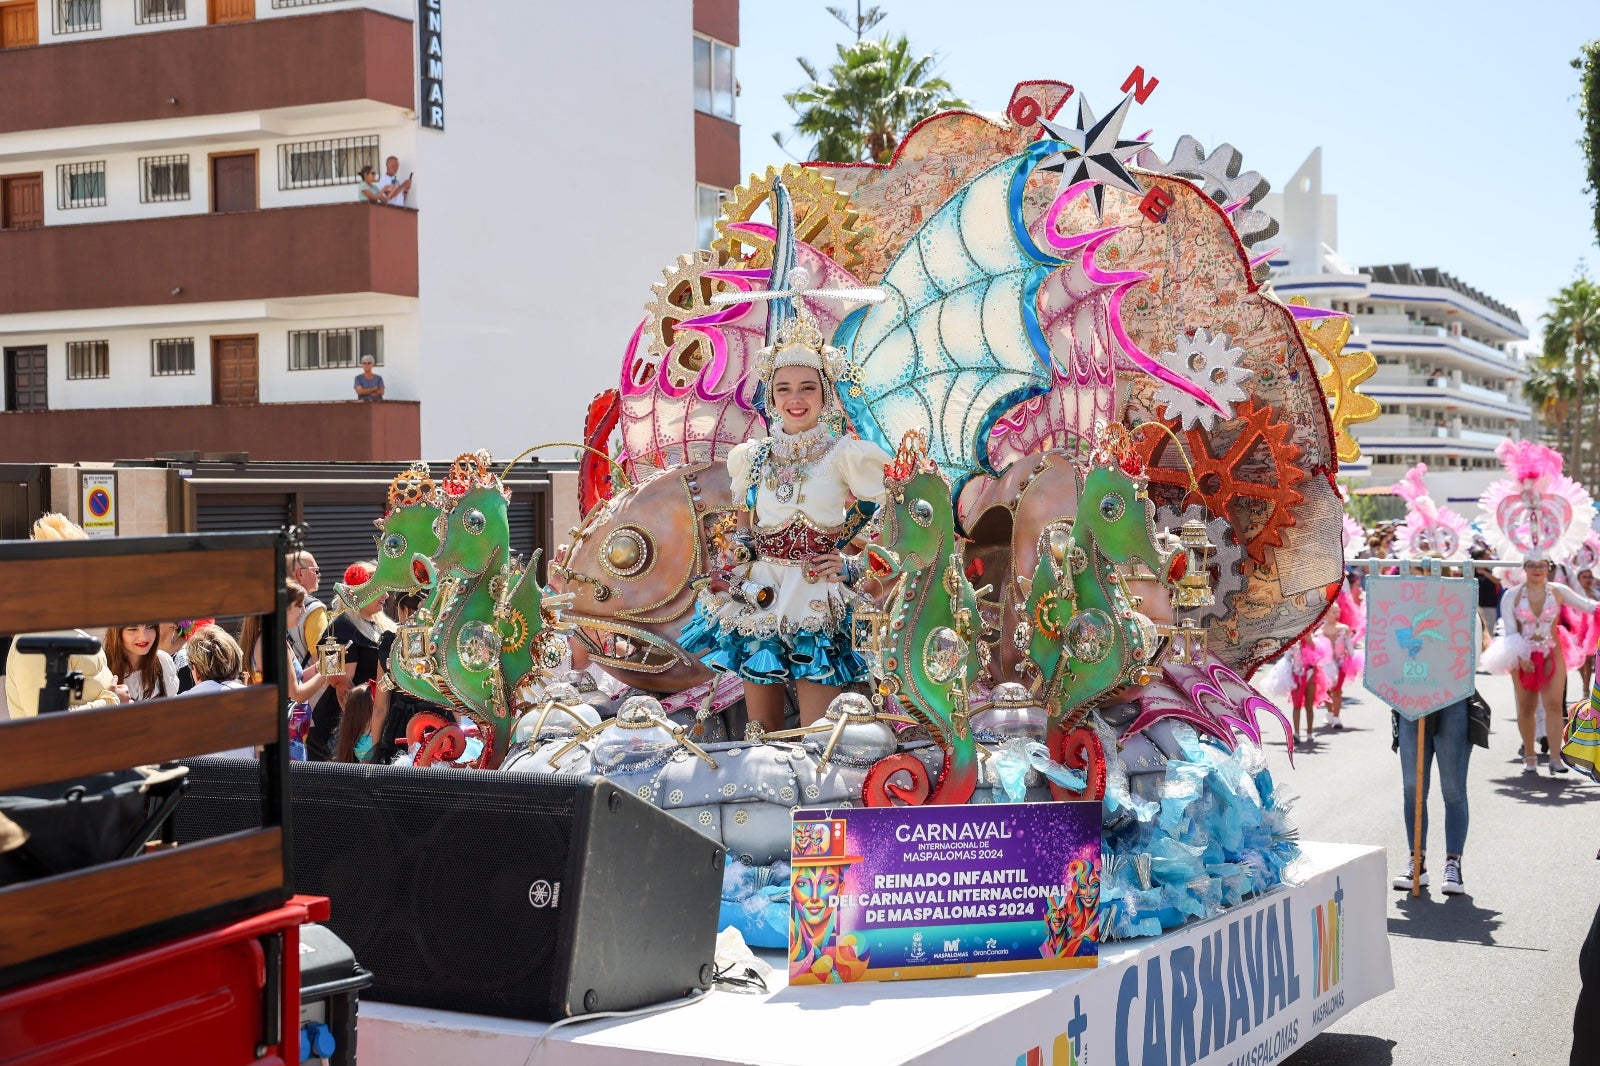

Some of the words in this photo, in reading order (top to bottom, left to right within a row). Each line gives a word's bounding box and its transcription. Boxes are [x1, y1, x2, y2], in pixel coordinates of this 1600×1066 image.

[1368, 600, 1397, 668] BRISA
[1402, 582, 1427, 603] DE
[1406, 663, 1424, 675] 20
[1378, 683, 1456, 710] COMPARSA
[895, 822, 1012, 842] CARNAVAL
[903, 850, 976, 862] MASPALOMAS
[978, 849, 1003, 859] 2024
[918, 841, 978, 851] INTERNACIONAL
[979, 841, 989, 849] DE
[874, 872, 951, 889] REINADO
[953, 869, 1028, 886] INFANTIL
[551, 882, 561, 908] YAMAHA
[828, 895, 856, 908] DEL
[858, 890, 944, 907] CARNAVAL
[947, 885, 1067, 902] INTERNACIONAL
[866, 909, 885, 923] DE
[888, 904, 997, 922] MASPALOMAS
[999, 902, 1034, 917] 2024
[933, 951, 968, 959] MASPALOMAS
[1115, 897, 1300, 1066] CARNAVAL
[1312, 990, 1345, 1027] MASPALOMAS
